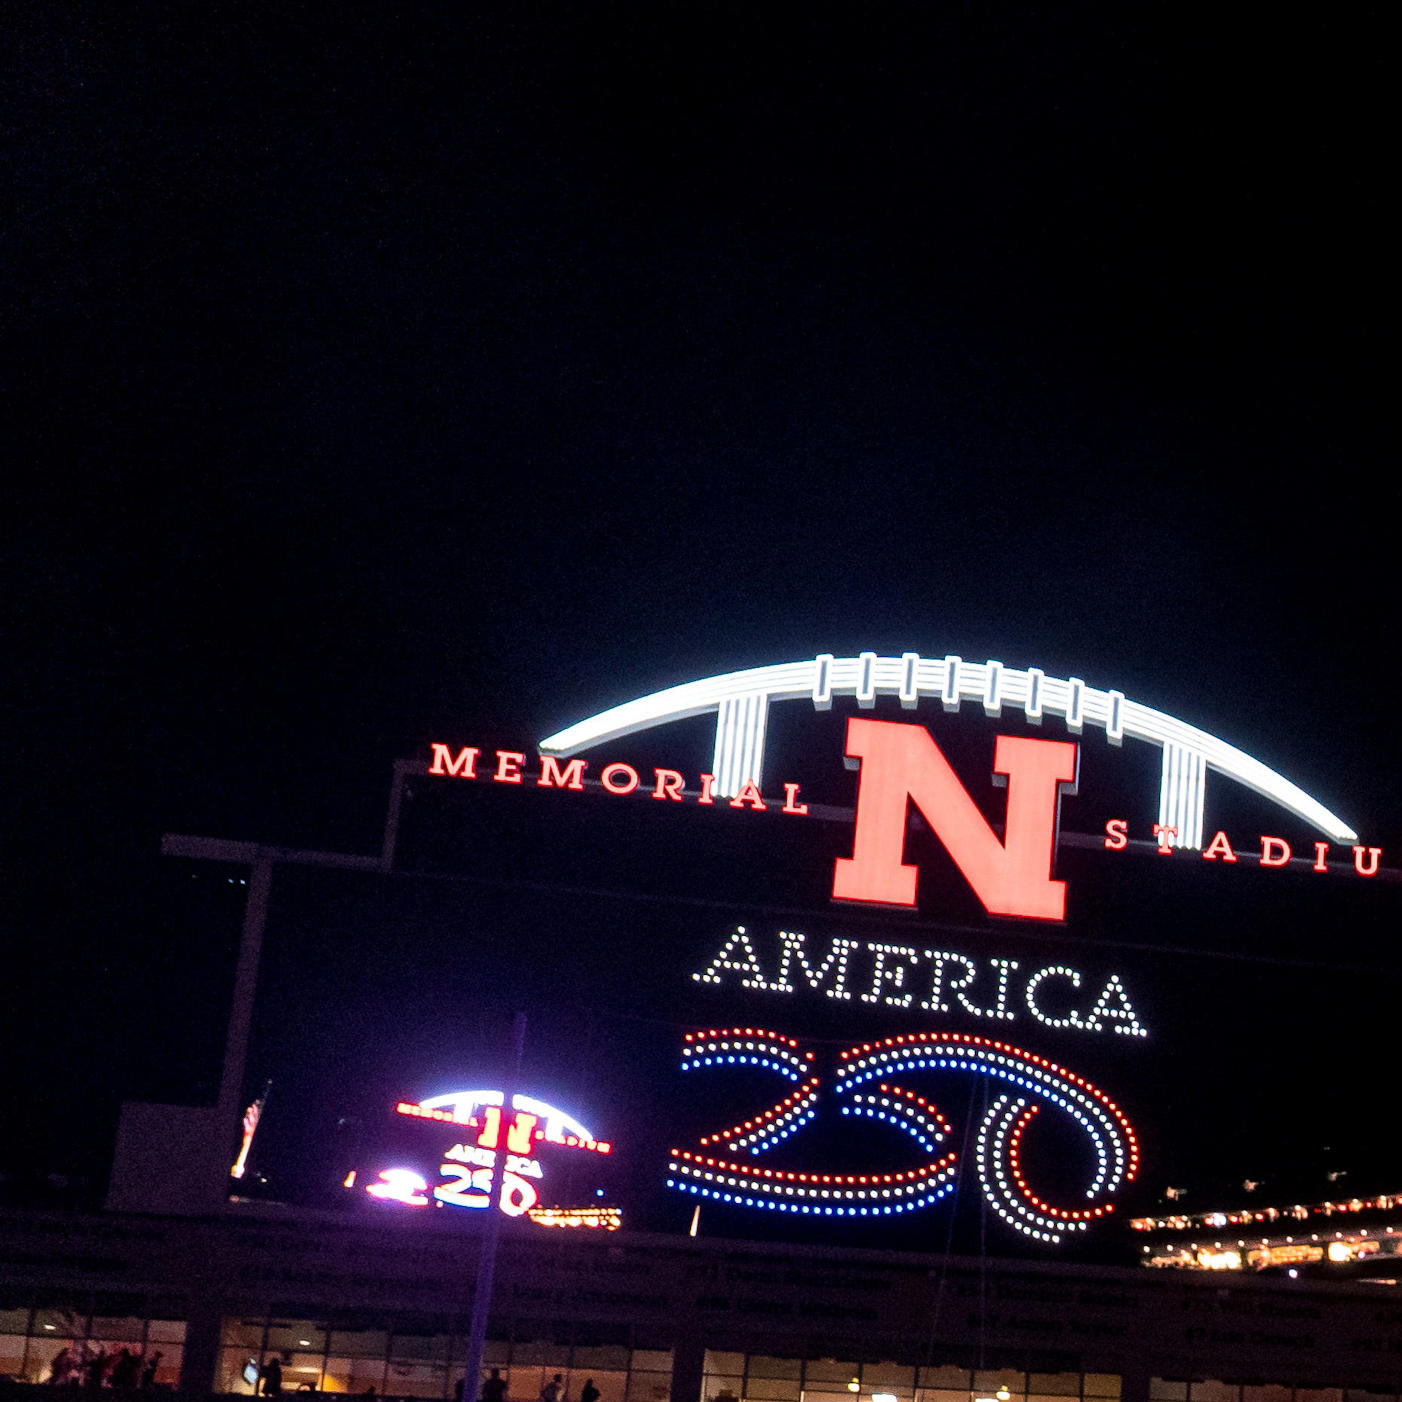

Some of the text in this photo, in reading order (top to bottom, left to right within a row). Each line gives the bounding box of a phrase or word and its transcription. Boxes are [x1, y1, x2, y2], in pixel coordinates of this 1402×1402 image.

[428, 742, 809, 815] MEMORIAL
[832, 716, 1078, 922] N
[691, 924, 1148, 1037] AMERICA
[444, 1143, 543, 1179] AMEICA
[666, 1027, 1140, 1243] 250
